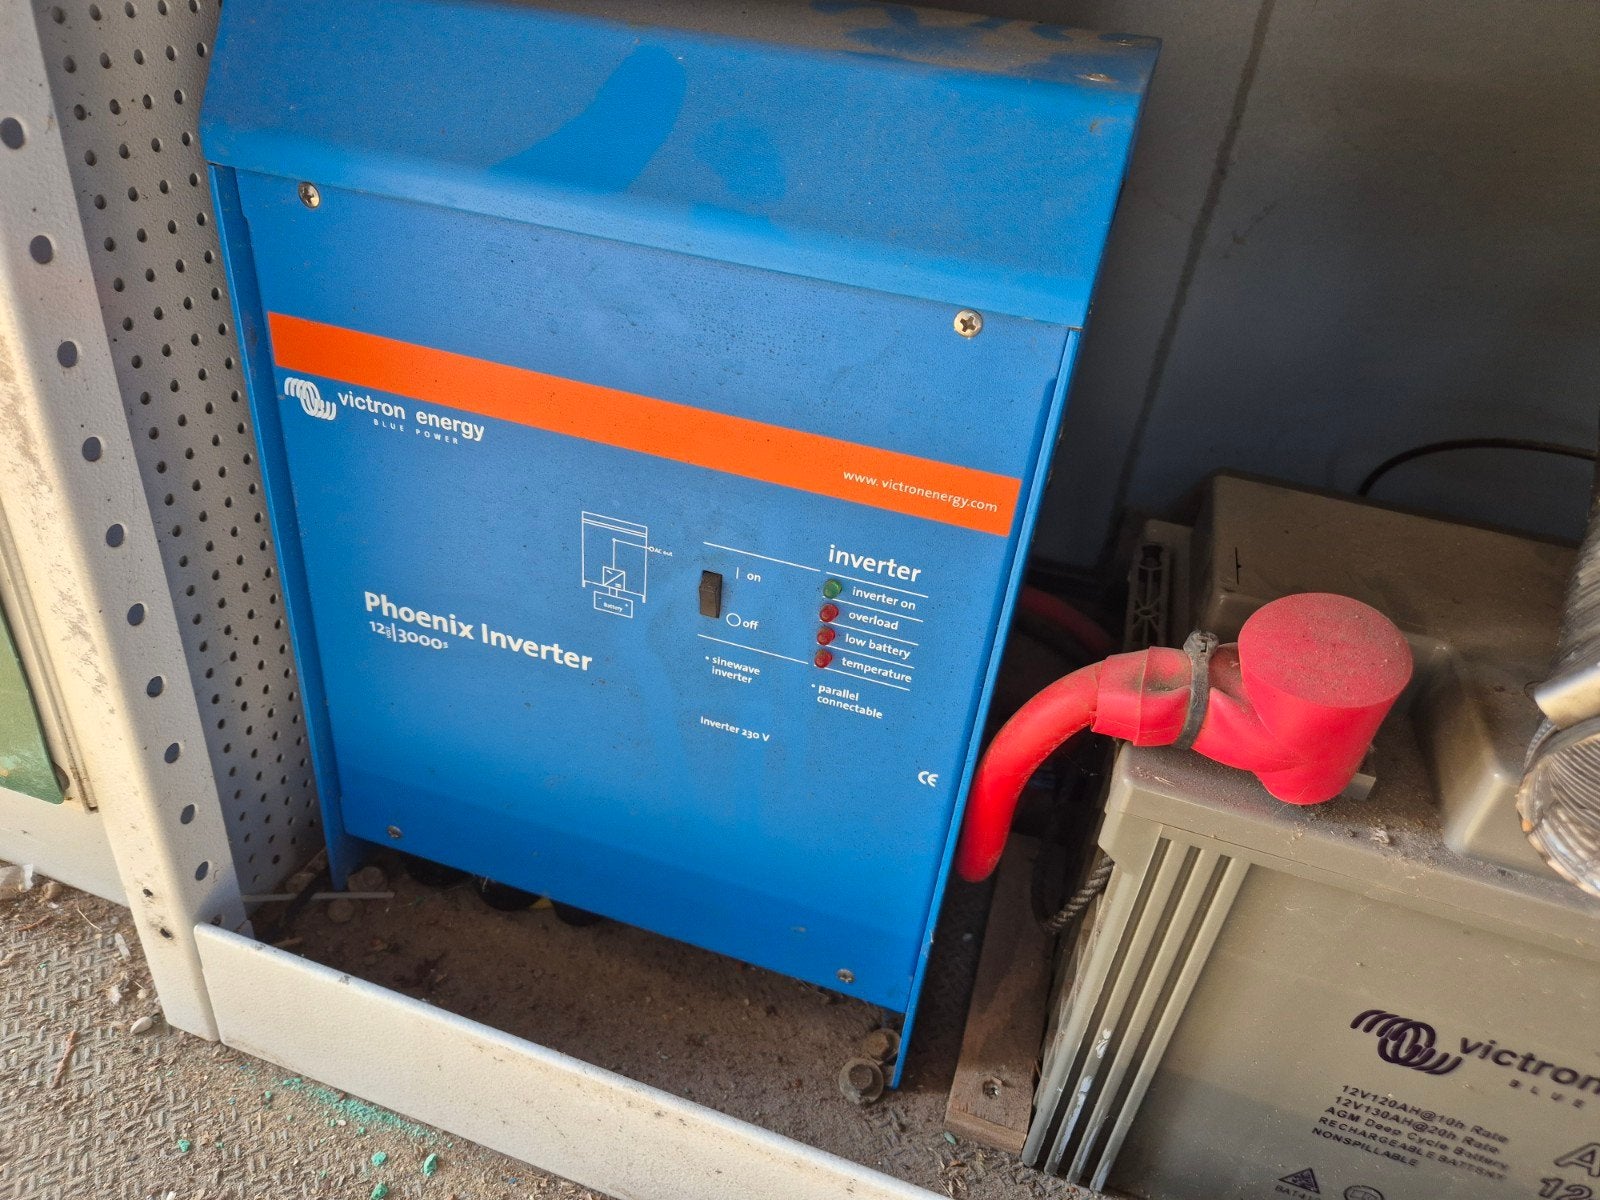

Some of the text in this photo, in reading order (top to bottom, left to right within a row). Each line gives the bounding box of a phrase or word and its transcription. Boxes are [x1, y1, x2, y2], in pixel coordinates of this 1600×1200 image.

[338, 391, 485, 442] victron energy
[373, 418, 459, 445] BLUE POWER
[843, 471, 998, 513] www. victronenergy.com
[828, 544, 922, 583] inverter
[746, 573, 761, 582] on
[852, 586, 917, 611] inverter on
[364, 591, 593, 671] Phoenix Inverter
[742, 620, 760, 630] off
[848, 611, 899, 630] overload
[845, 633, 911, 660] low battery
[711, 665, 753, 684] inverter
[712, 656, 761, 675] sinewave
[841, 657, 912, 683] temperature
[818, 683, 860, 702] parallel
[816, 696, 884, 719] connectable
[700, 716, 771, 742] Inverter 230 V
[1460, 1036, 1600, 1095] victron
[1335, 1096, 1457, 1140] 12V130AH@20h
[1342, 1085, 1466, 1130] 12V120AH@10h
[1318, 1116, 1436, 1159] RECHARGEABLE
[1325, 1107, 1361, 1122] AGM
[1364, 1118, 1402, 1136] Deep
[1407, 1132, 1449, 1151] Cycle
[1312, 1127, 1419, 1166] NONSPILLABLE
